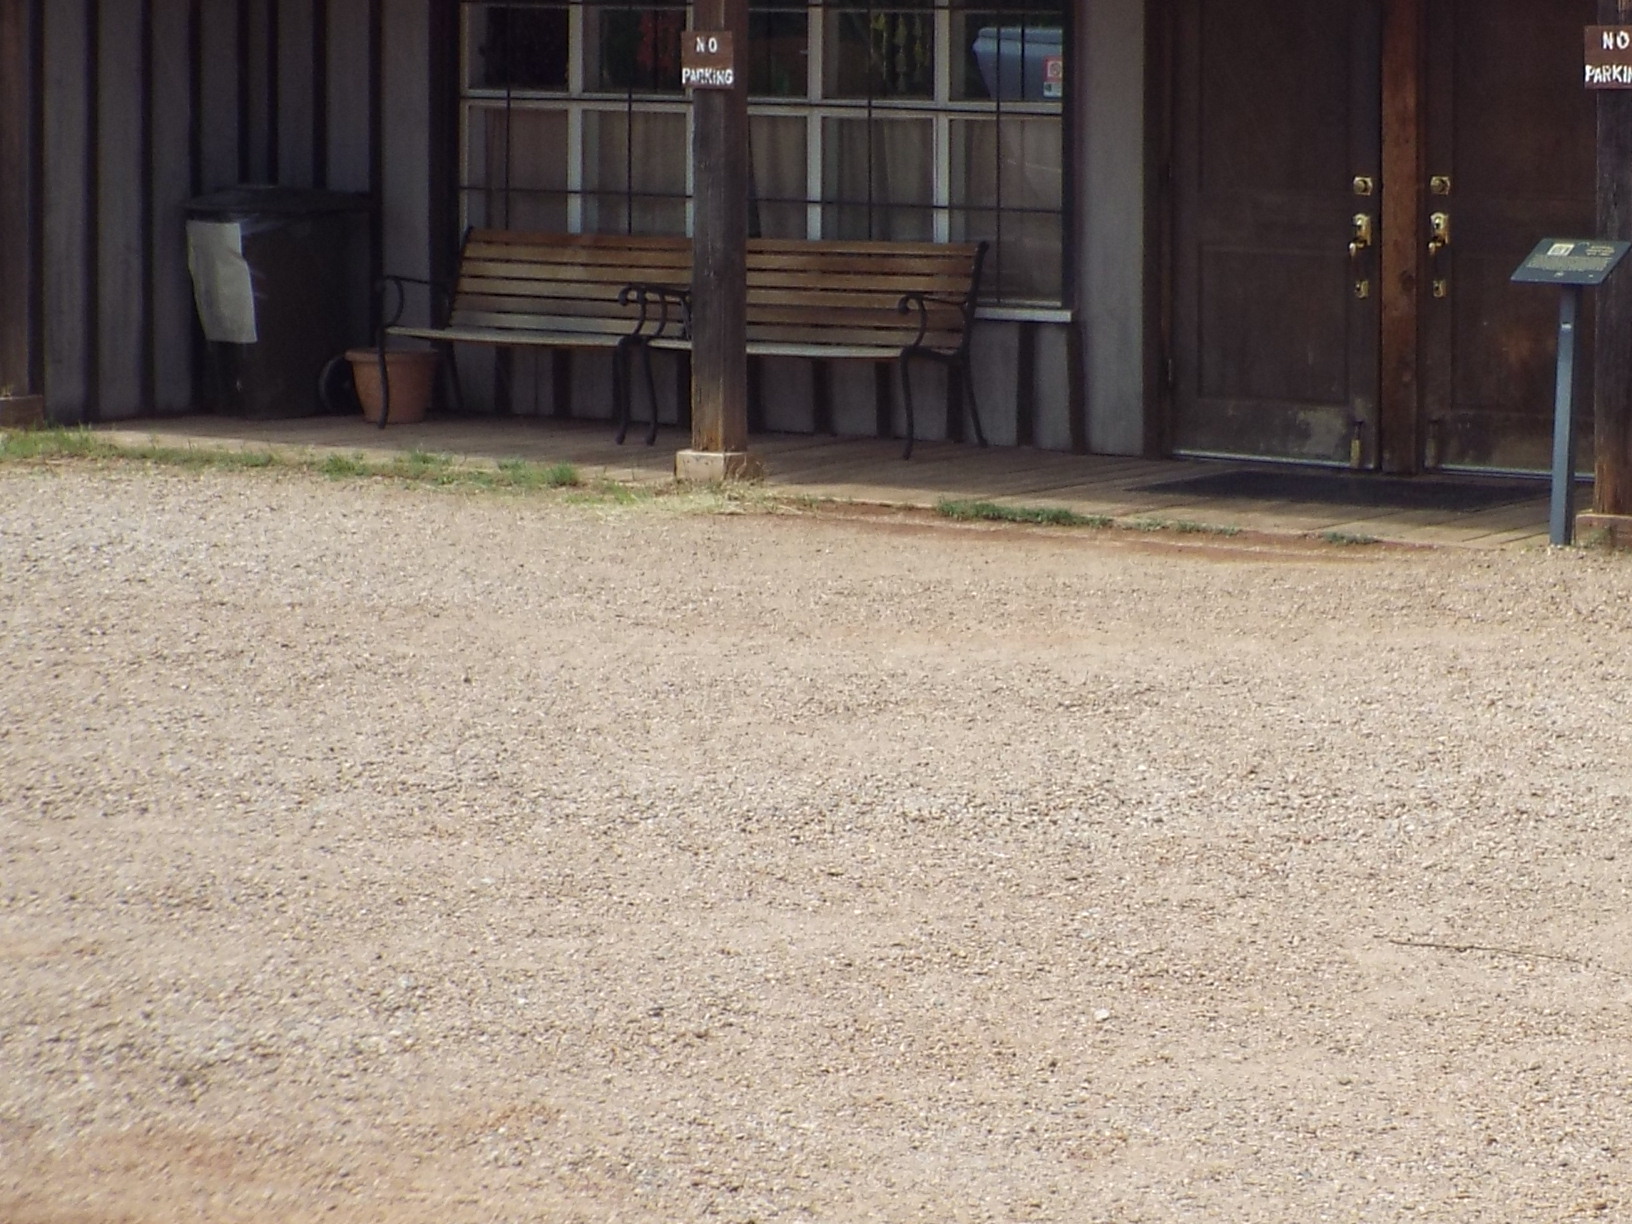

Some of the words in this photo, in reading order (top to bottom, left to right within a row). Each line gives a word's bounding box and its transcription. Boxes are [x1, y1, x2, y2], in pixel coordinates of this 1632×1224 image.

[696, 36, 718, 53] NO
[1602, 30, 1630, 50] NO
[681, 67, 734, 85] PARKING
